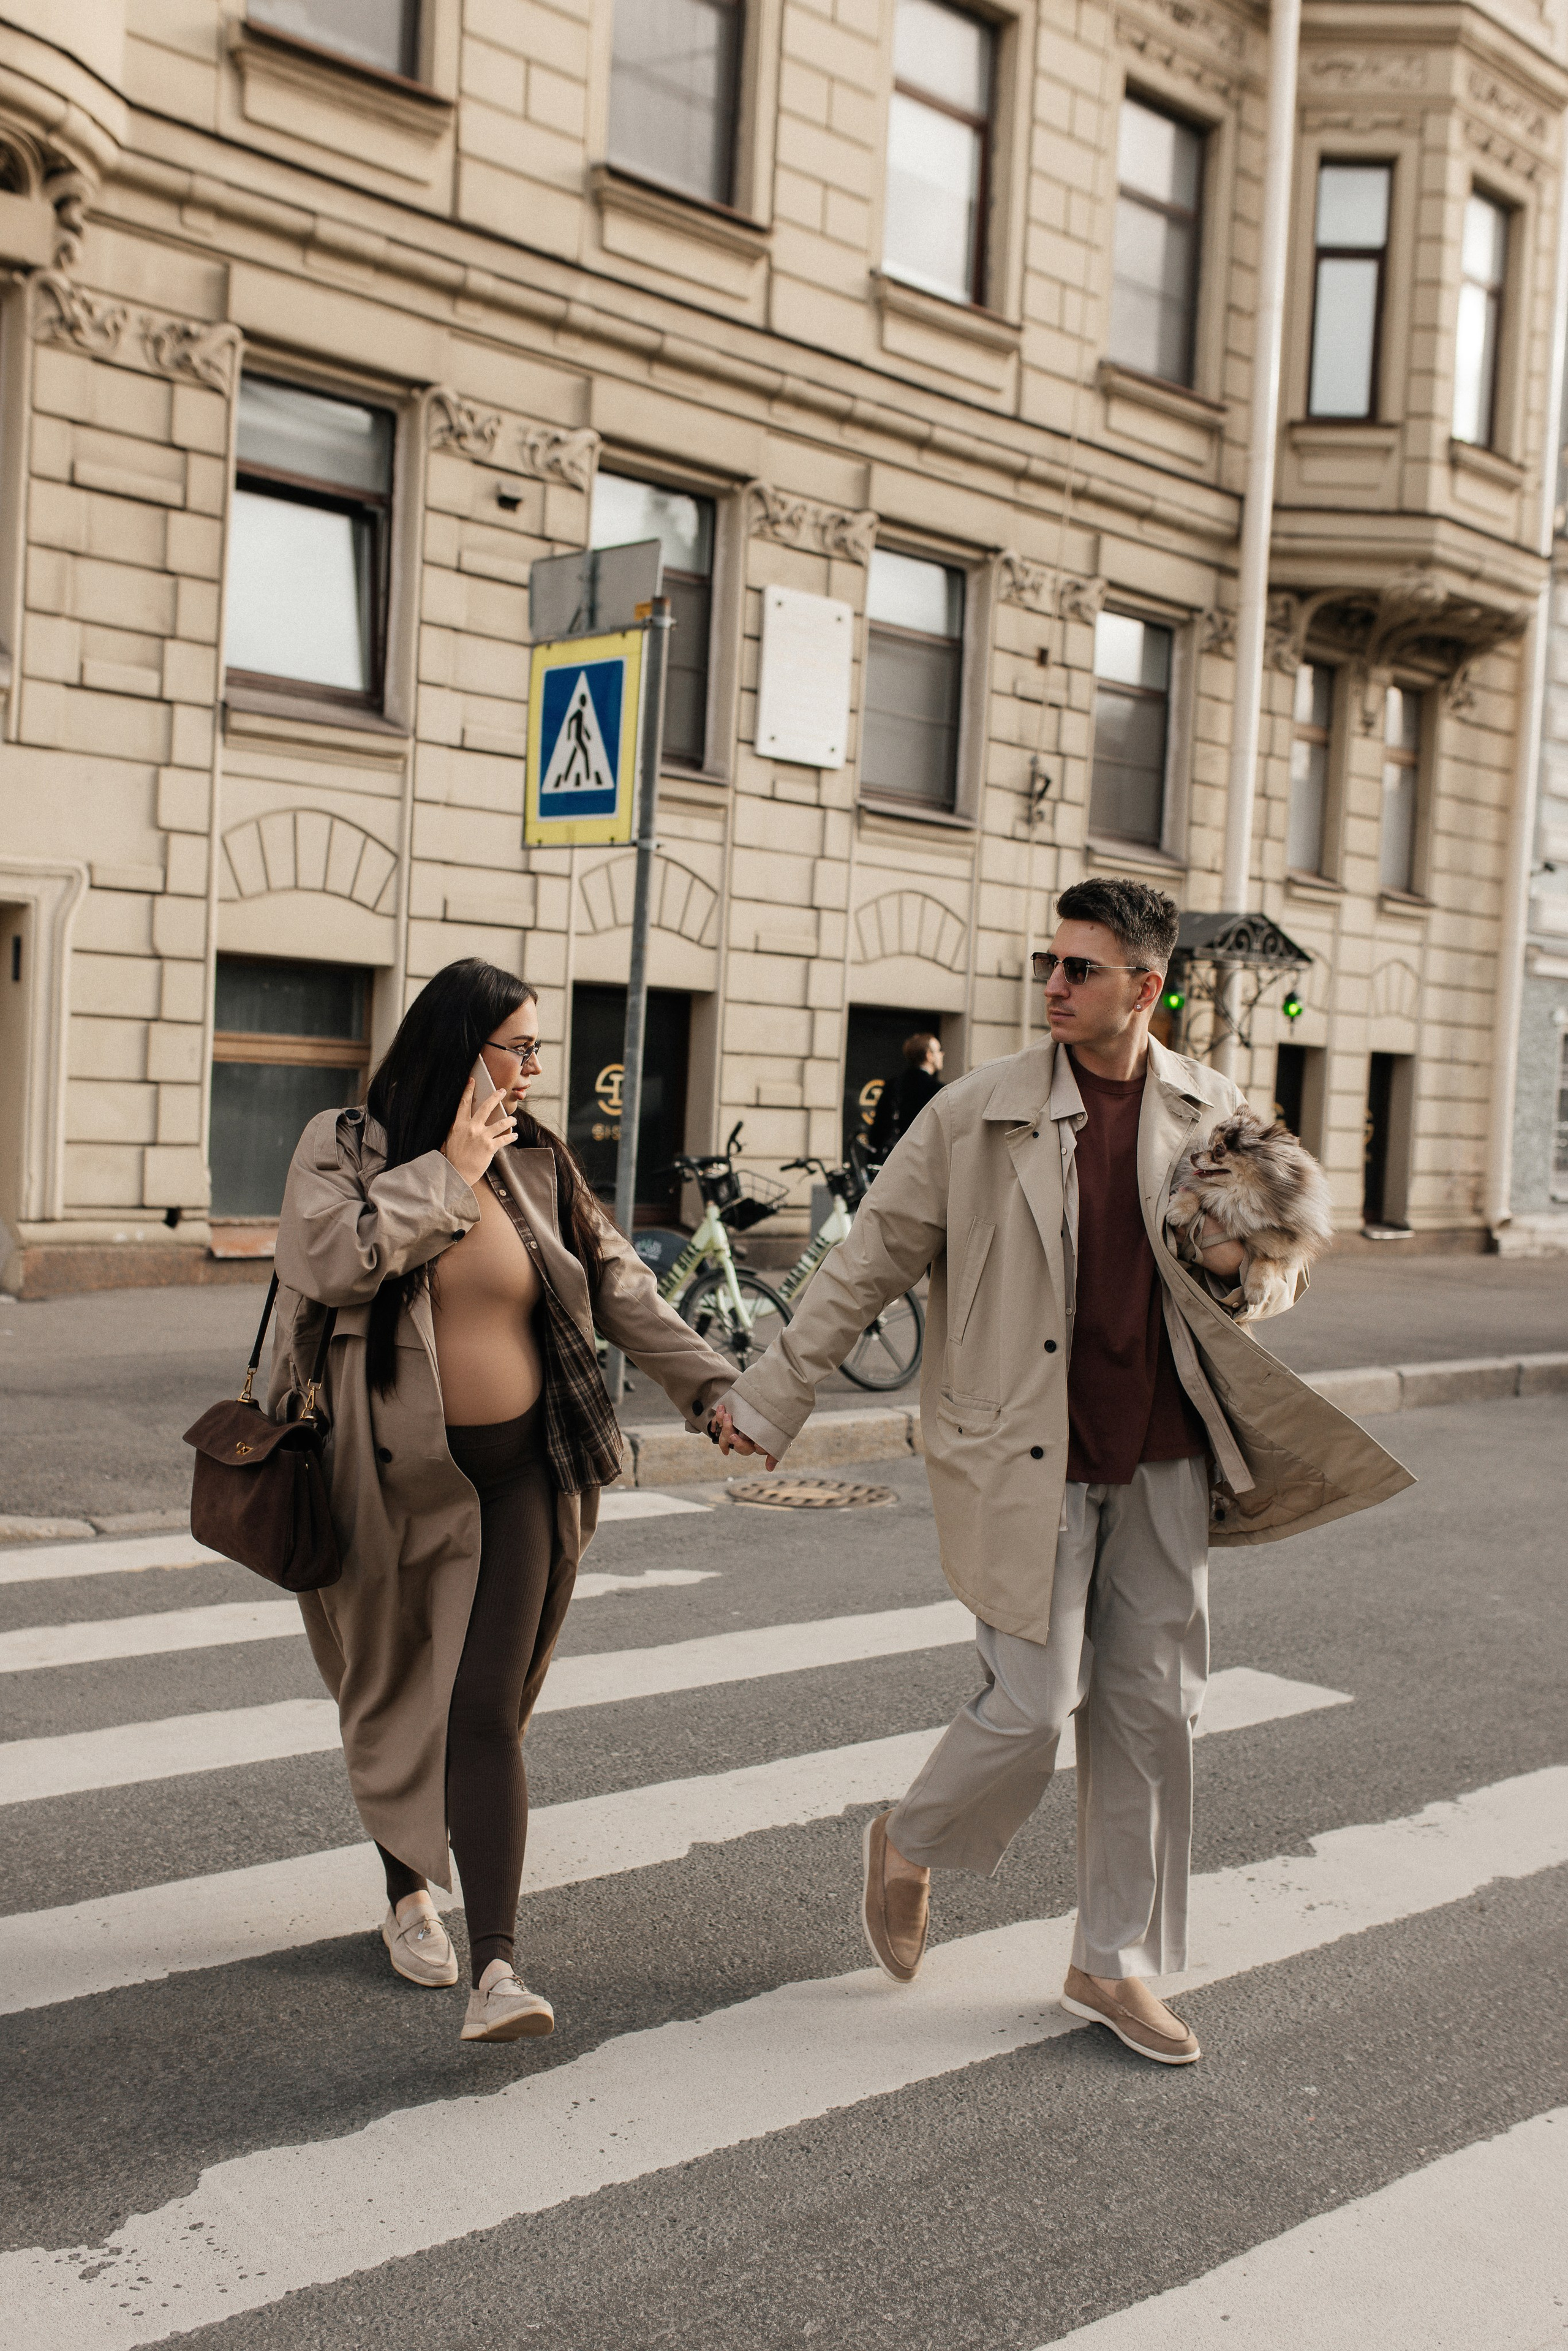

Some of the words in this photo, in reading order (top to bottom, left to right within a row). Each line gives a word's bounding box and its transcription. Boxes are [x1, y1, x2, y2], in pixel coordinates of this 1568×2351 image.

[676, 1241, 701, 1270] BIKE
[778, 1259, 811, 1298] SMART
[805, 1232, 830, 1262] BIKE
